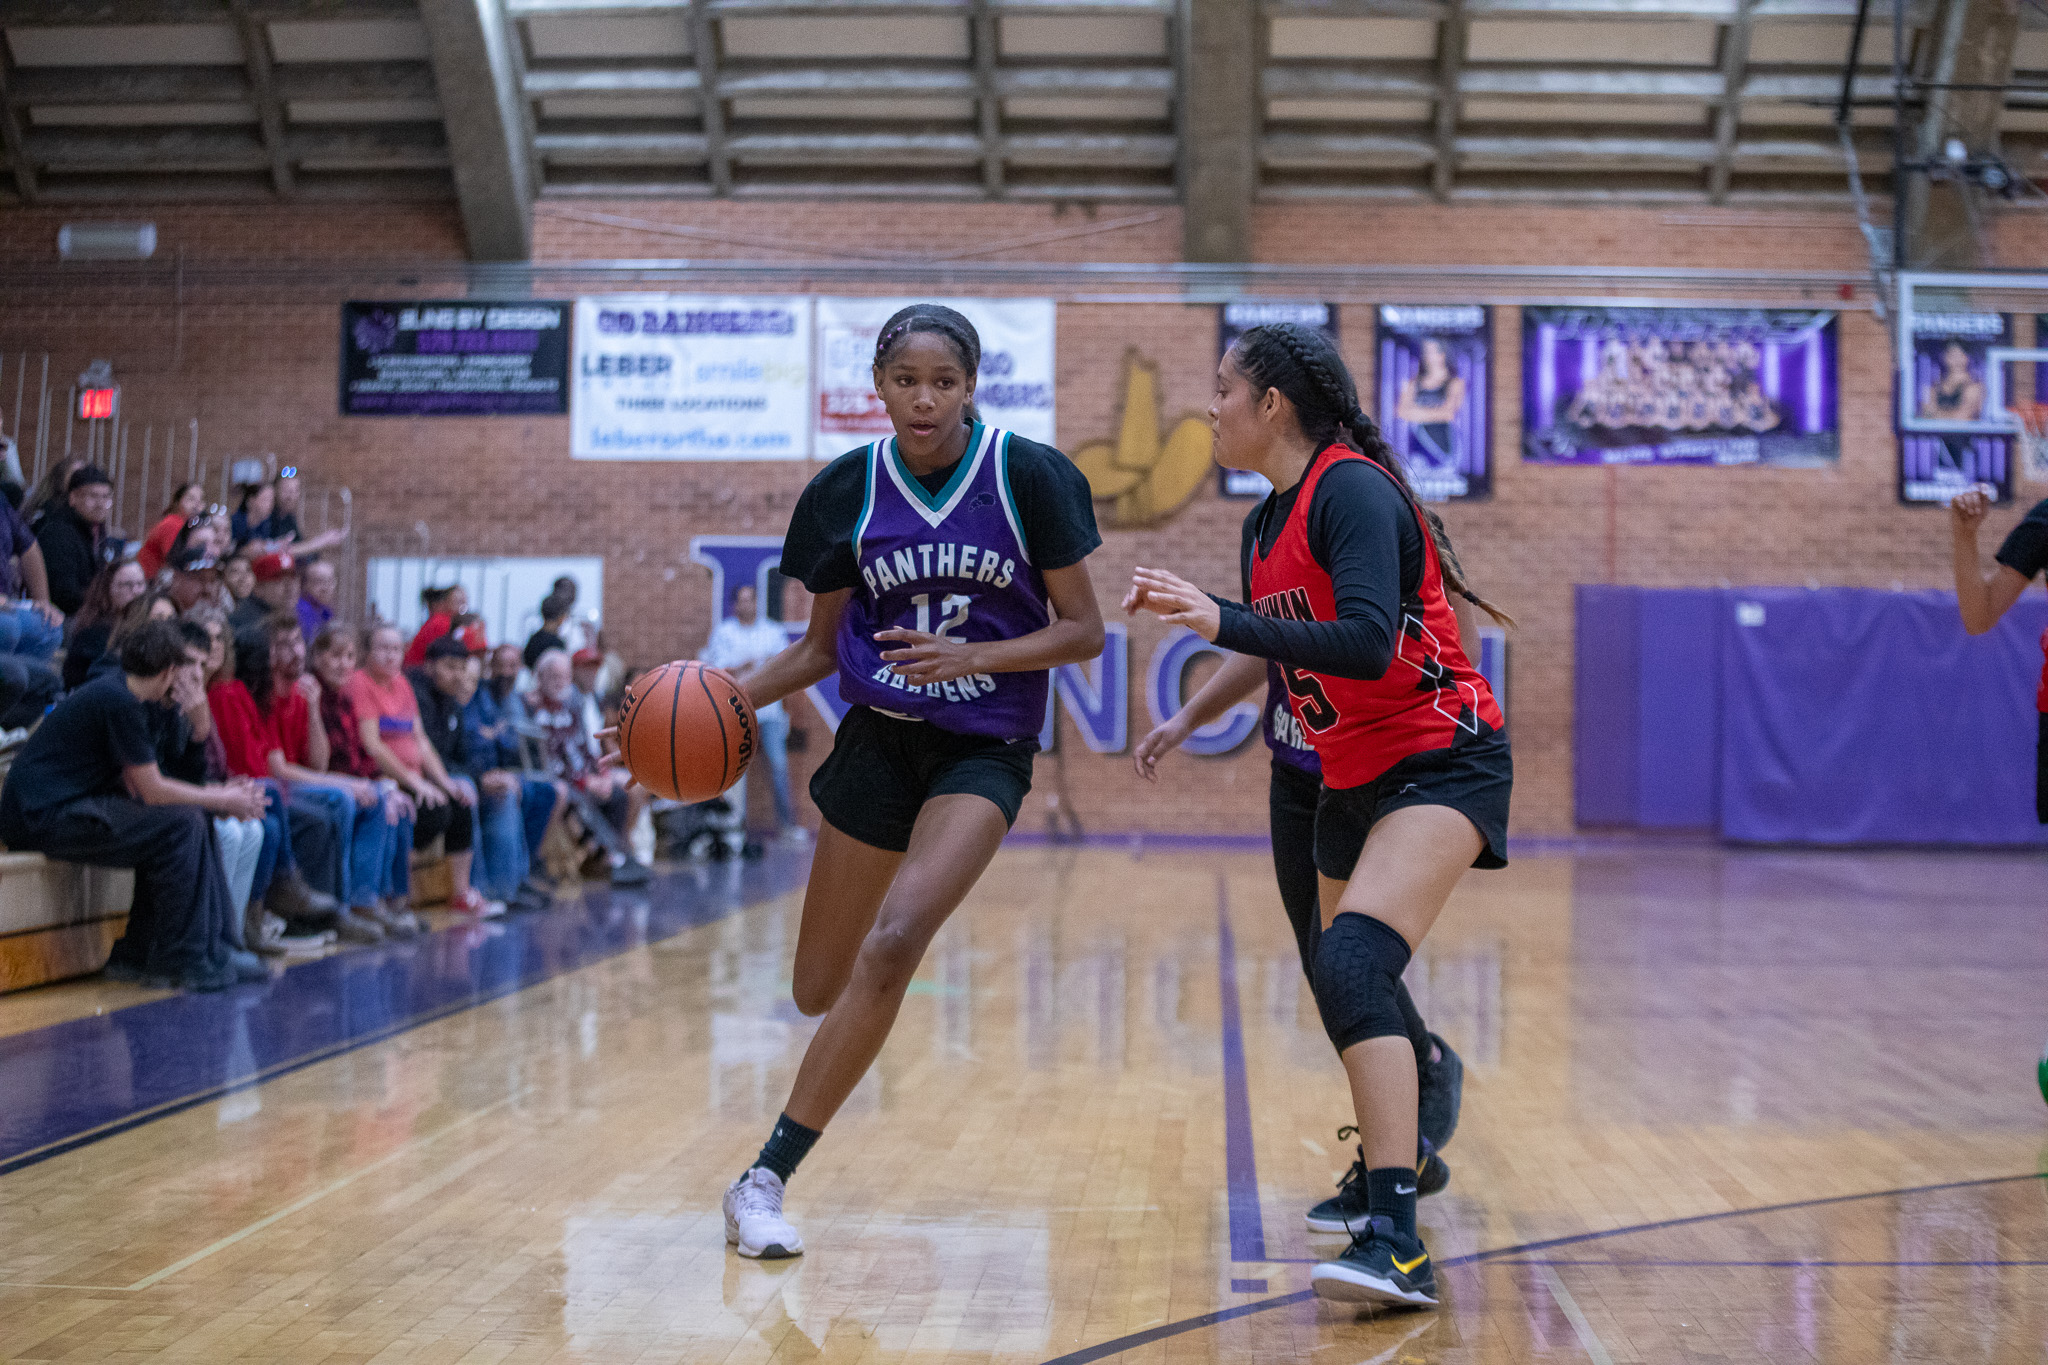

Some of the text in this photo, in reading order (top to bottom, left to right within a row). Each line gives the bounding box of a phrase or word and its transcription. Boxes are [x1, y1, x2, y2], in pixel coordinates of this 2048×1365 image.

[582, 354, 673, 377] LEBER
[862, 543, 1015, 600] PANTHERS
[911, 593, 972, 645] 12
